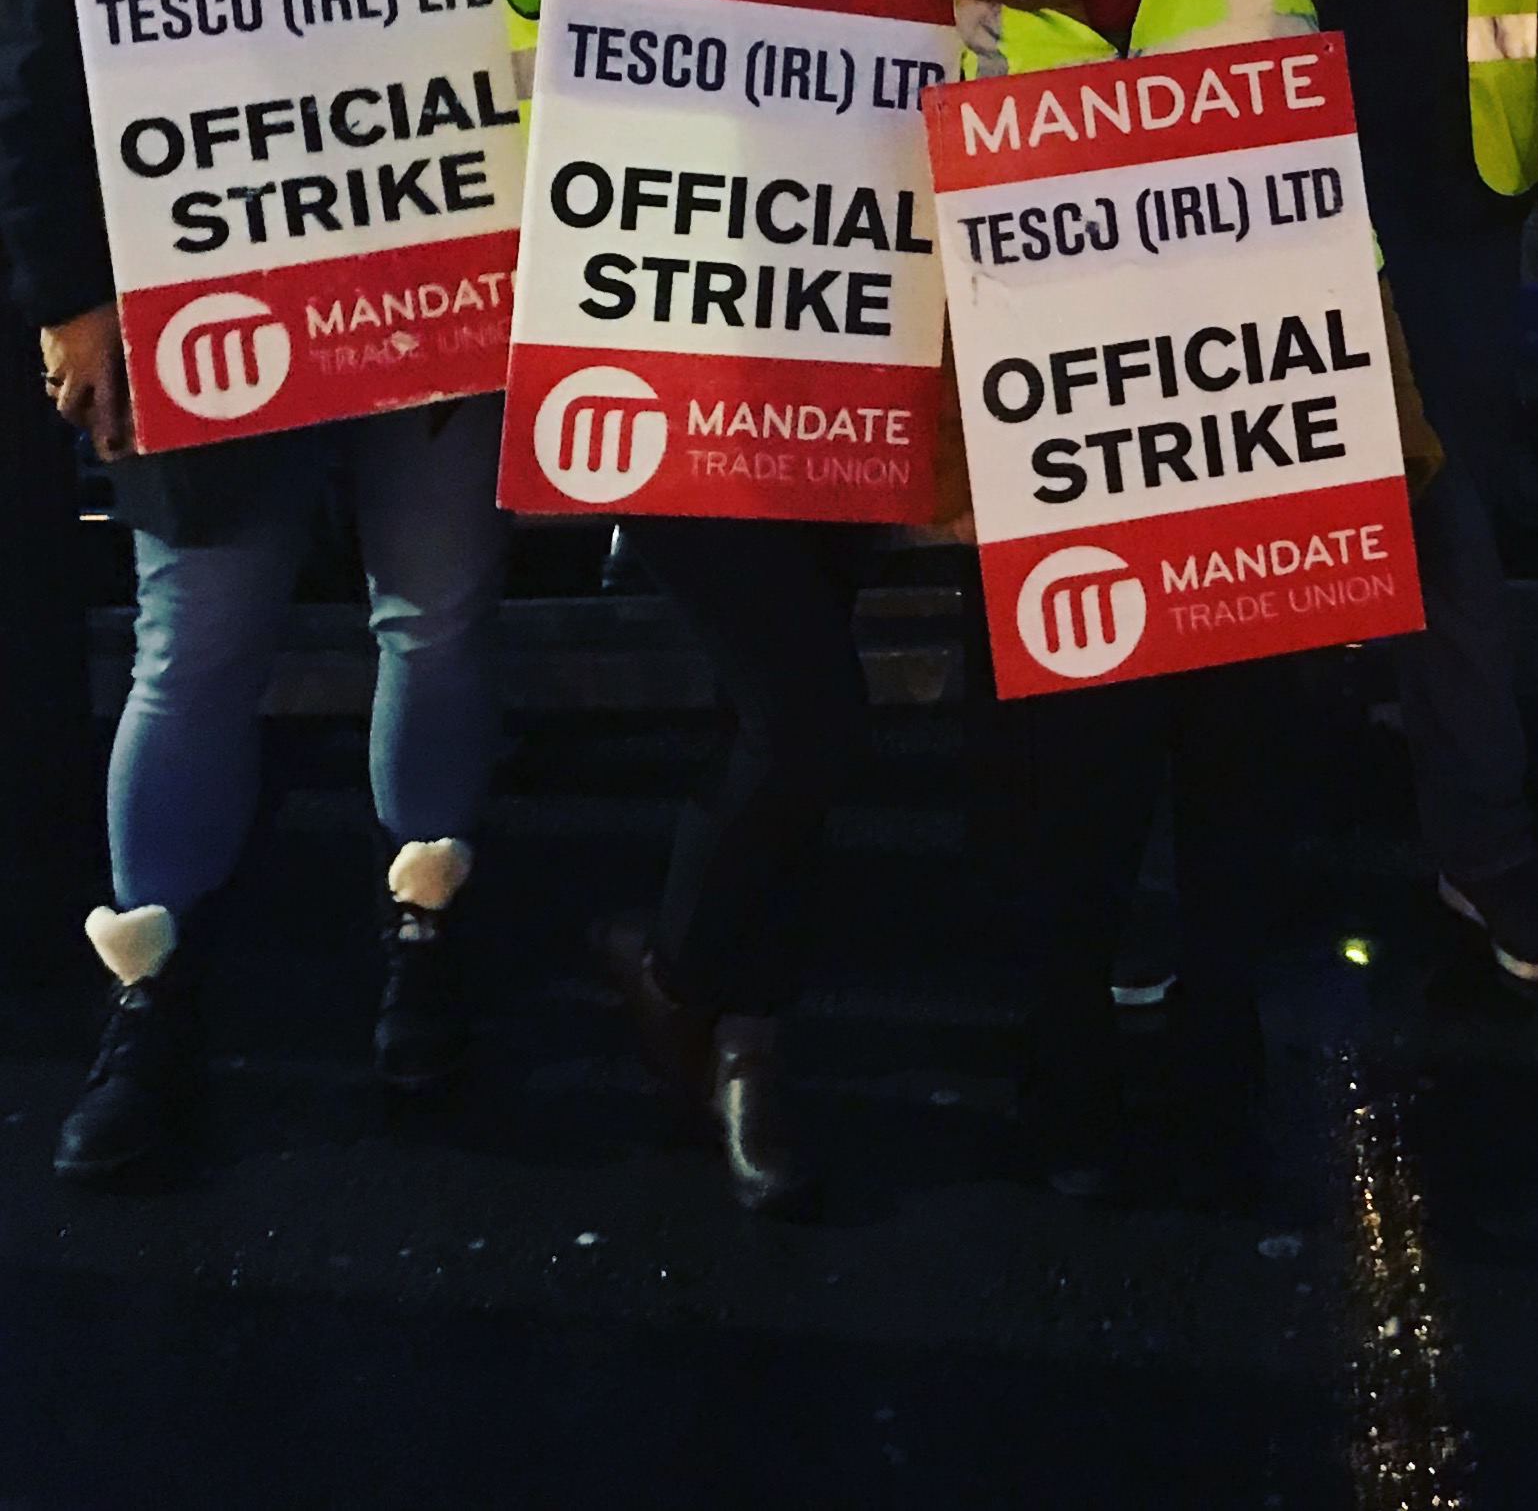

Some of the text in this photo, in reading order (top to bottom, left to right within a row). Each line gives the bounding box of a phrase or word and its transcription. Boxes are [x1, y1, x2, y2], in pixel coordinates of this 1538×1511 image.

[567, 23, 728, 93] TESCO
[745, 39, 855, 115] (IRL)
[959, 52, 1327, 158] MANDATE
[119, 69, 520, 178] OFFICIAL
[171, 150, 496, 254] STRIKE
[550, 160, 934, 255] OFFICIAL
[1135, 175, 1250, 255] (IRL)
[1264, 166, 1345, 226] LTD
[304, 270, 519, 340] MANDAT
[578, 251, 893, 336] STRIKE
[981, 307, 1372, 425] OFFICIAL
[686, 399, 911, 446] MANDATE
[686, 447, 911, 486] TRADE UNION
[1031, 395, 1346, 506] STRIKE
[1160, 523, 1389, 596] MANDATE
[1168, 572, 1396, 635] TRADE UNION
